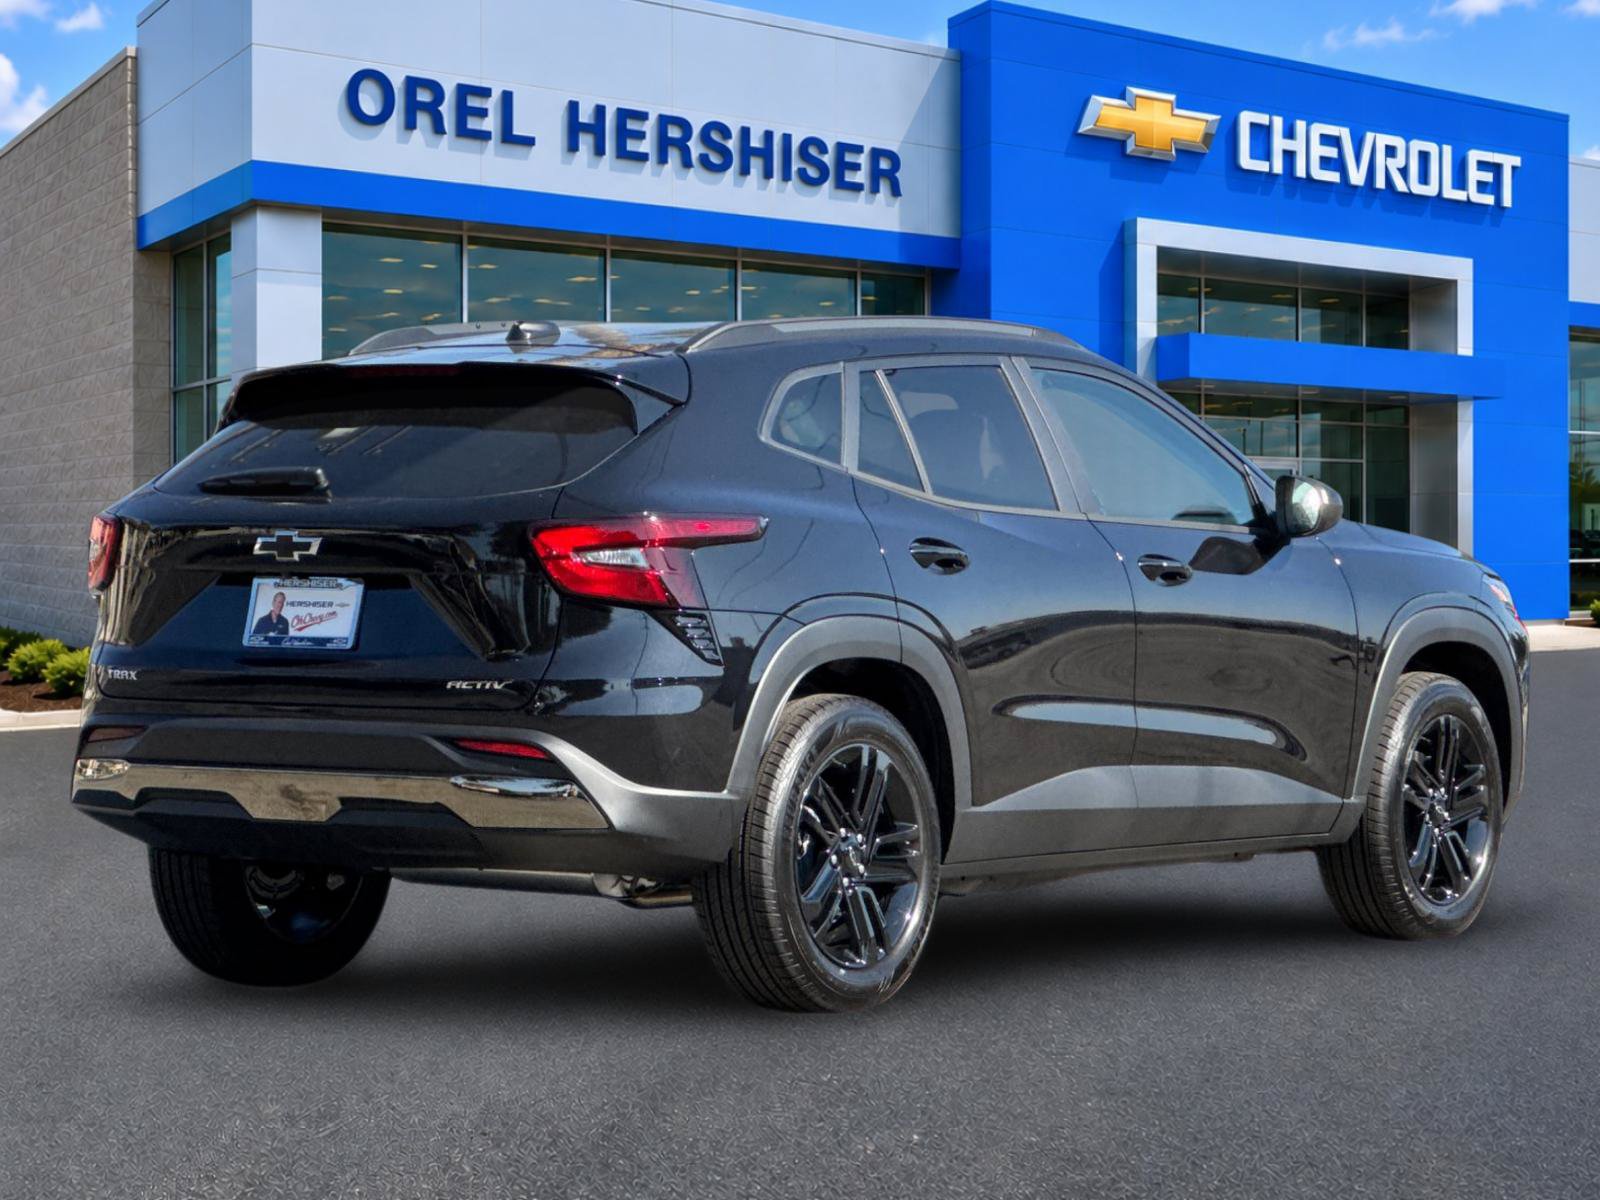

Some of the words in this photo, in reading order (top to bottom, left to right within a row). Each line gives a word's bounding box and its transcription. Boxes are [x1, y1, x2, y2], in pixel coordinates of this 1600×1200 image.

[347, 68, 535, 146] OREL
[567, 99, 902, 198] HERSHISER
[1238, 110, 1521, 208] CHEVROLET
[279, 579, 337, 588] HERSHISER
[286, 600, 334, 608] HERSHISER
[107, 669, 138, 681] TRAX
[446, 680, 513, 689] ACTIV
